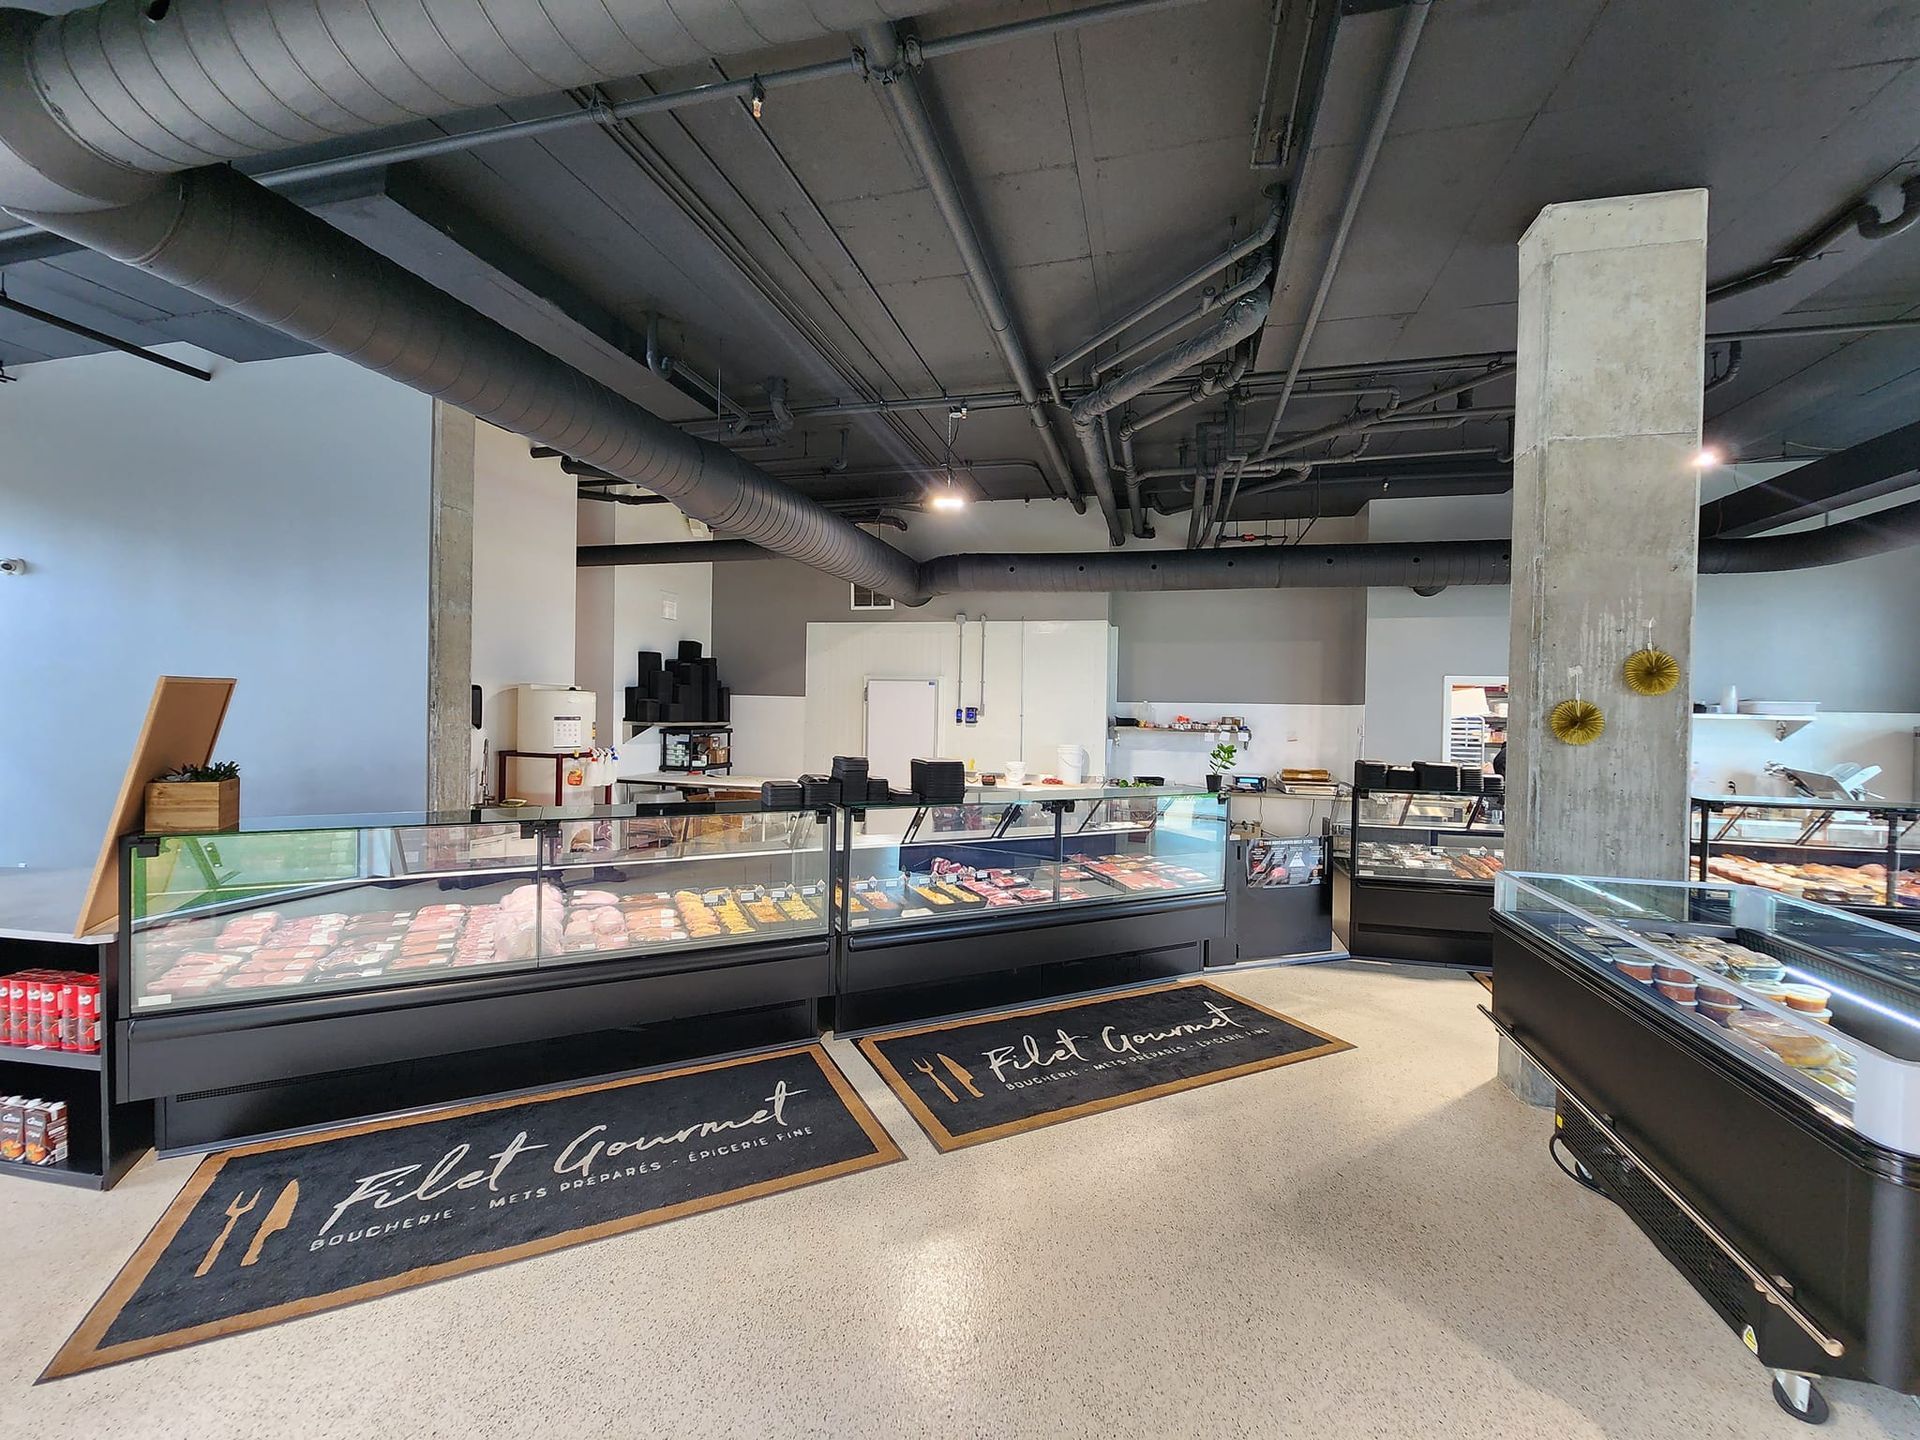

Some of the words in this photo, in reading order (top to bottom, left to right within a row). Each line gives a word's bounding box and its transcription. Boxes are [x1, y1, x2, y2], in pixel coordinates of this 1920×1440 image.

[981, 1028, 1090, 1083] Filet
[1101, 1000, 1245, 1055] Gourmet
[1005, 1069, 1079, 1091] BOUCHERIE
[1093, 1059, 1127, 1072] METS
[309, 1208, 454, 1252] BOUCHERIE
[489, 1186, 548, 1210] METS
[559, 1161, 662, 1192] PRÉPARÉS
[688, 1137, 769, 1163] ÉPICERIE
[776, 1126, 813, 1142] FINE
[317, 1131, 549, 1237] Filet
[553, 1080, 810, 1178] Gourmet
